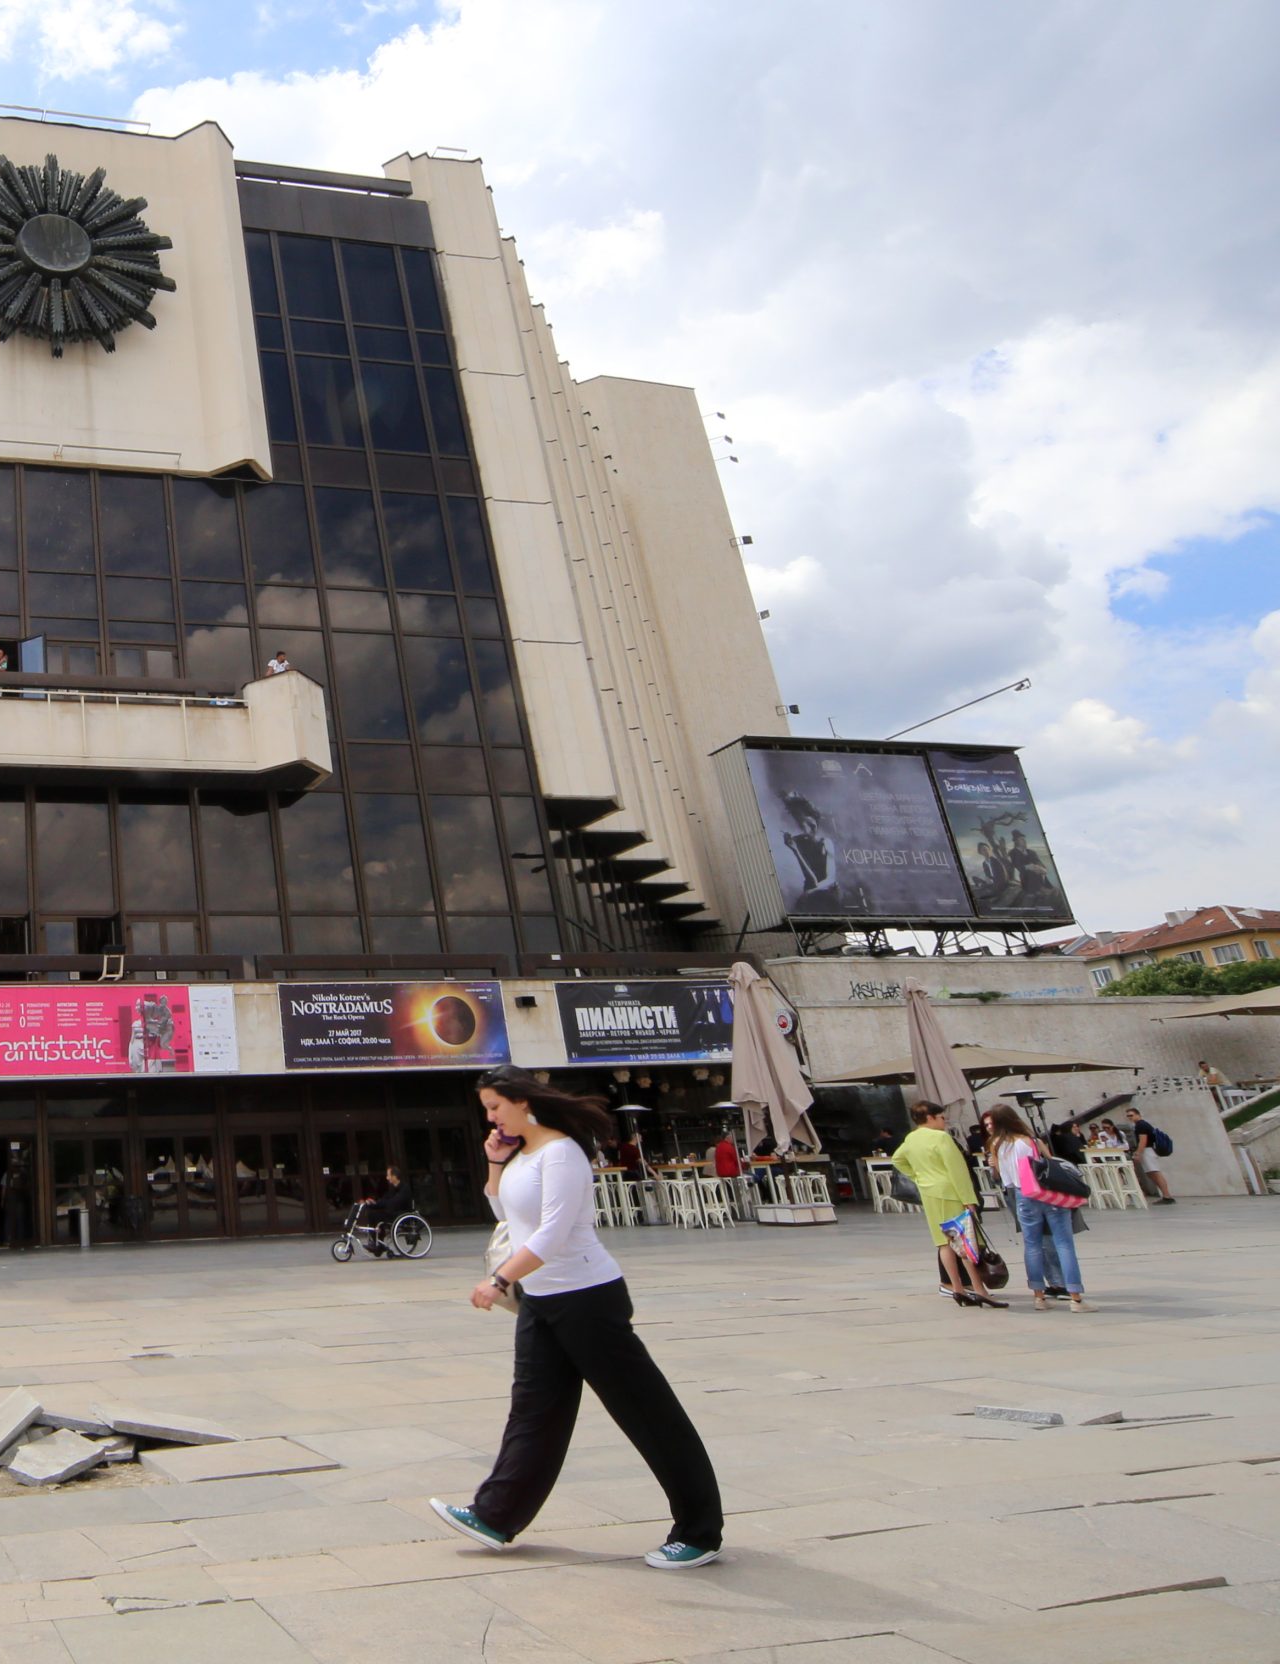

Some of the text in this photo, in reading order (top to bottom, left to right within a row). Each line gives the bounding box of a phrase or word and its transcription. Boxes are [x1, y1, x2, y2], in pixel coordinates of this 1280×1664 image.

[842, 848, 951, 868] КОРАБЪТ НОЩ
[312, 992, 370, 1002] Nikolo Kotzev's
[608, 999, 641, 1007] ЧЕТИРИМАТА
[575, 1006, 678, 1031] ПИАНИСТИ
[328, 1029, 334, 1037] 27
[336, 1028, 349, 1037] МАЙ
[0, 1034, 114, 1063] antistatic
